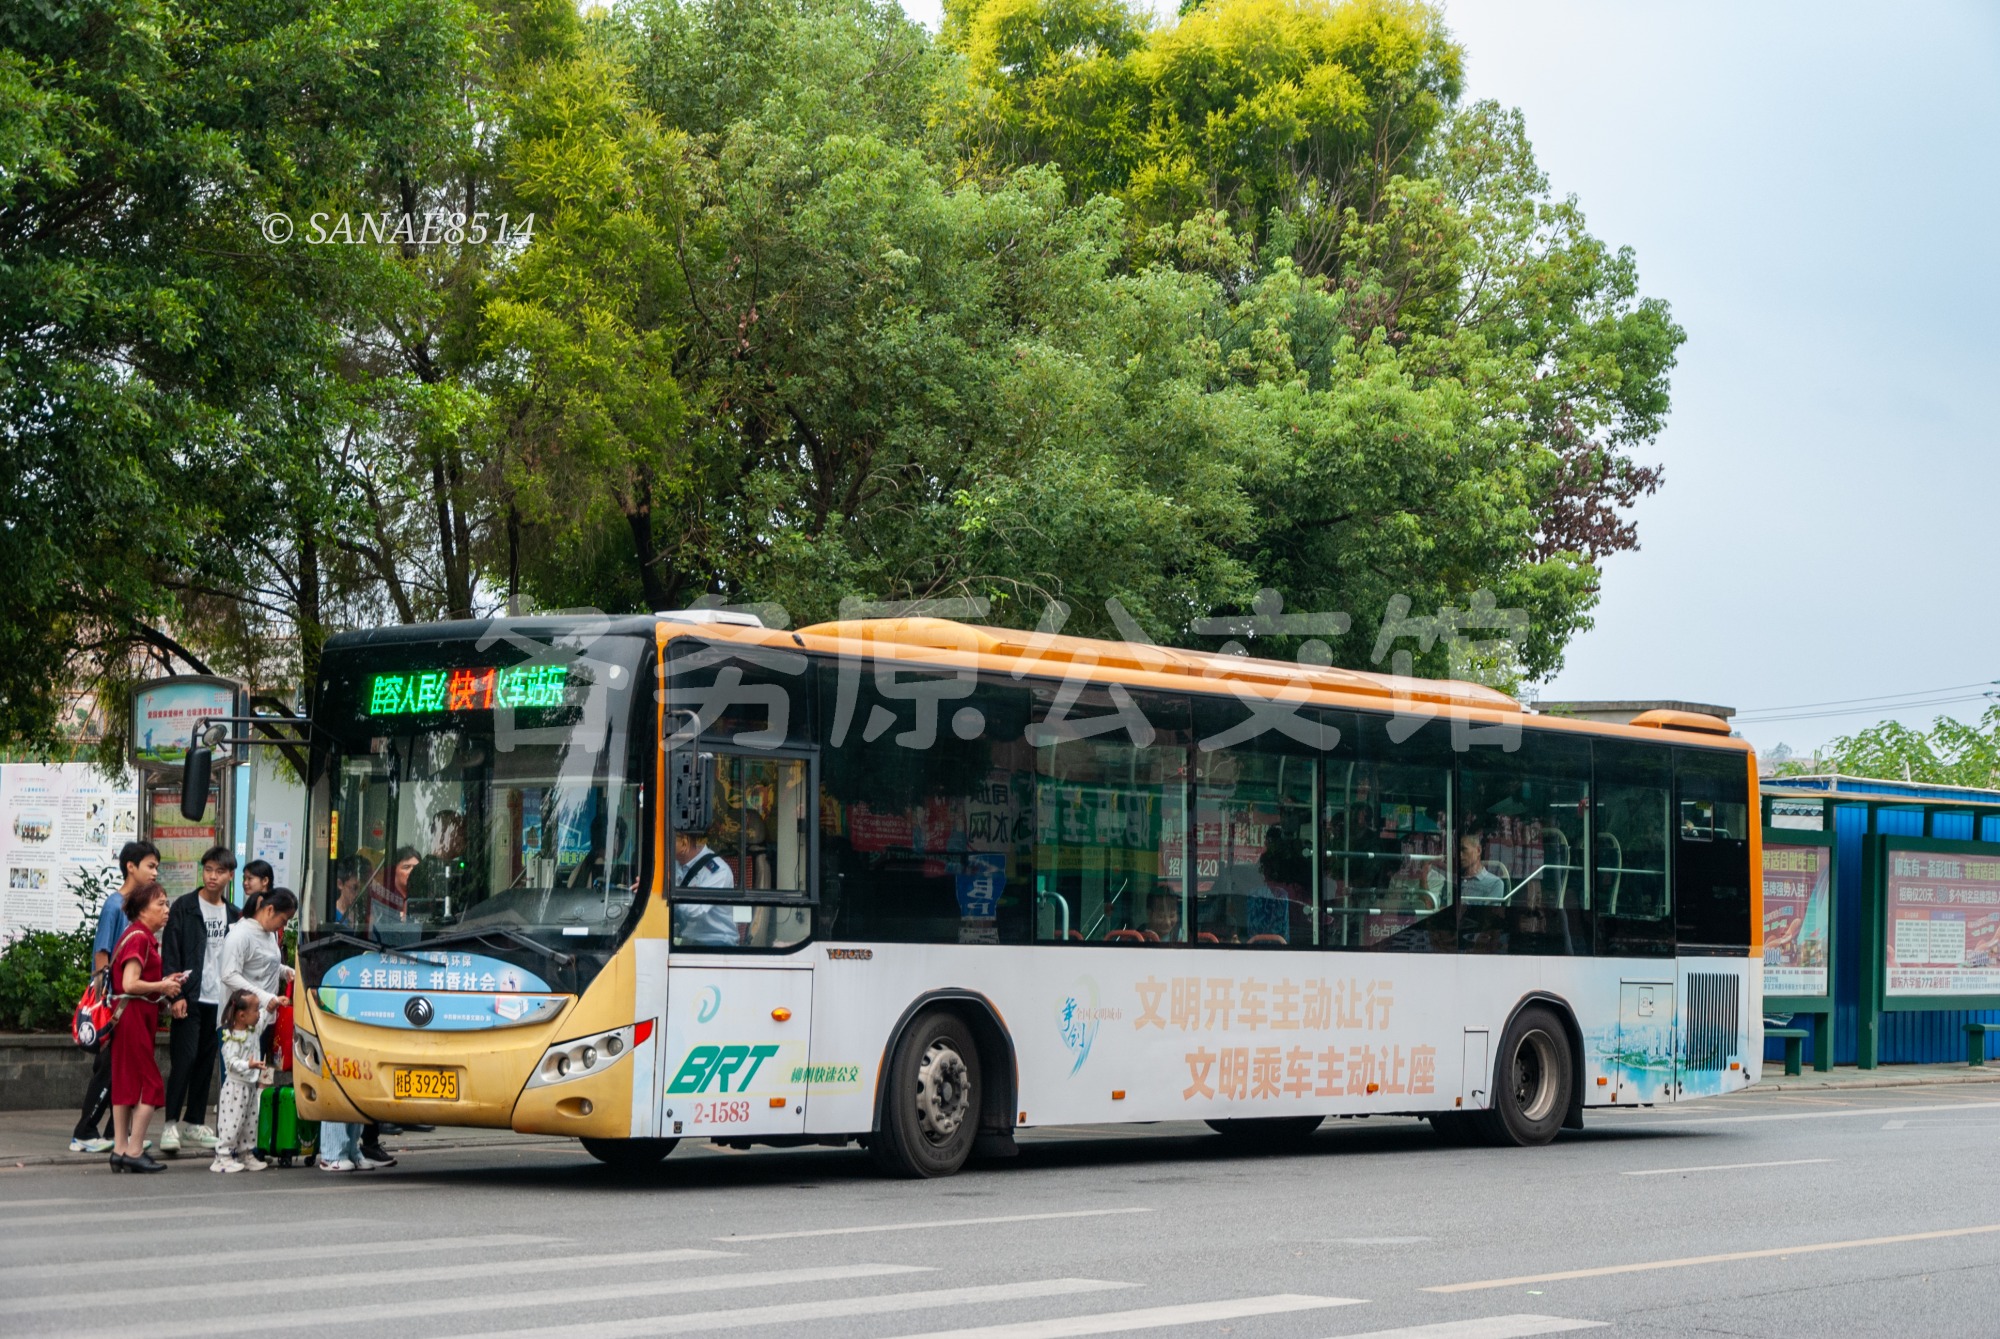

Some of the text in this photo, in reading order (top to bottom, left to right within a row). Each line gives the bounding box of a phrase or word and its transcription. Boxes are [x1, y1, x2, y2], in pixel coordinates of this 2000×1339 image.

[450, 668, 495, 711] 快1
[360, 968, 496, 991] 全民阅读 书香社会
[1133, 975, 1395, 1032] 文明开车主动让行
[666, 1045, 780, 1094] BRT
[790, 1065, 859, 1083] 柳州快速公交
[1182, 1044, 1438, 1101] 文明乘车主动让座
[694, 1101, 750, 1123] 2-1583
